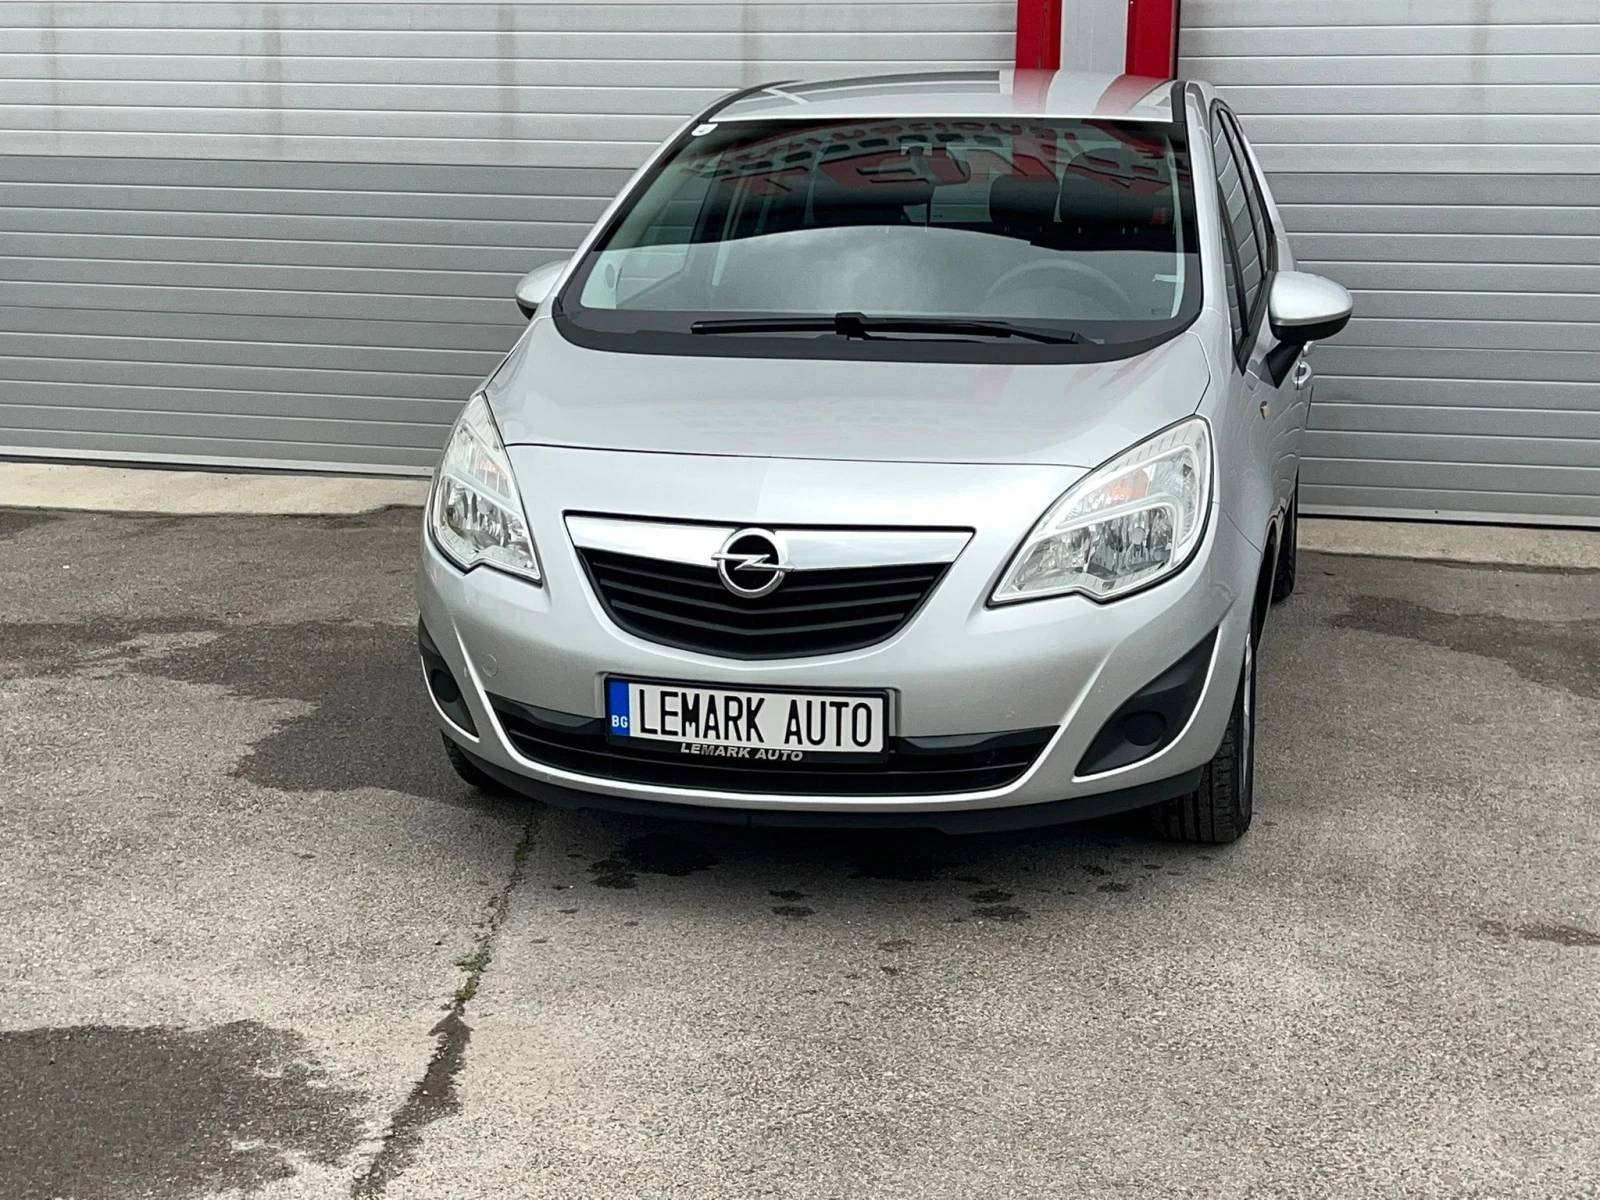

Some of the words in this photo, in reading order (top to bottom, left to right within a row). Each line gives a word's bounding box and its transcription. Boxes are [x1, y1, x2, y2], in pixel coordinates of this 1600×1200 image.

[611, 715, 629, 729] BG
[640, 689, 765, 743] LEMARK
[784, 699, 874, 747] AUTO
[680, 742, 753, 759] LEMARK
[754, 748, 804, 762] AUTO
